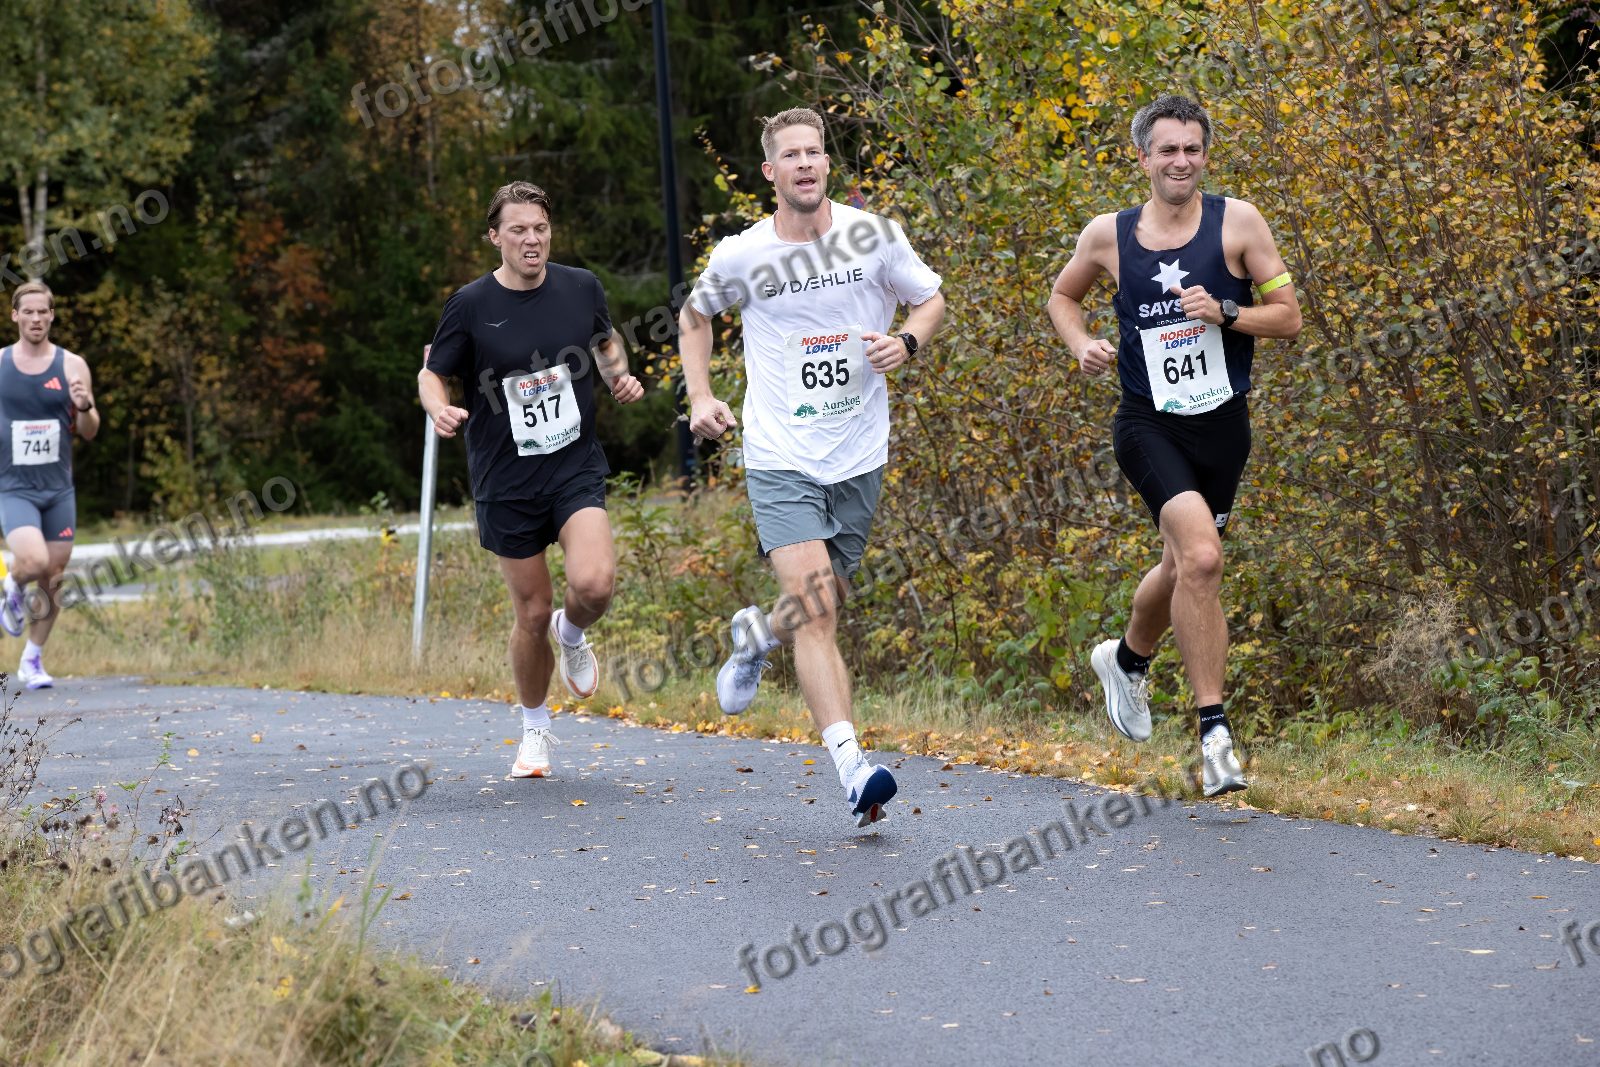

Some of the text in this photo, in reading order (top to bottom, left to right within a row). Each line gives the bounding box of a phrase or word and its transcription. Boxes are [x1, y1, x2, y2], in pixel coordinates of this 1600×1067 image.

[1139, 299, 1183, 318] SAYS
[801, 334, 848, 346] NORGES
[1160, 325, 1206, 342] NORGES
[1165, 335, 1199, 349] LØPET
[806, 343, 841, 354] LØPET
[801, 358, 849, 389] 635
[1164, 350, 1207, 384] 641
[519, 374, 558, 389] NORGES
[524, 383, 553, 397] LØPET
[822, 395, 860, 410] Aurskog
[1189, 385, 1230, 403] Aurskog
[523, 394, 561, 427] 517
[545, 425, 579, 443] Aurskog
[22, 439, 50, 456] 744
